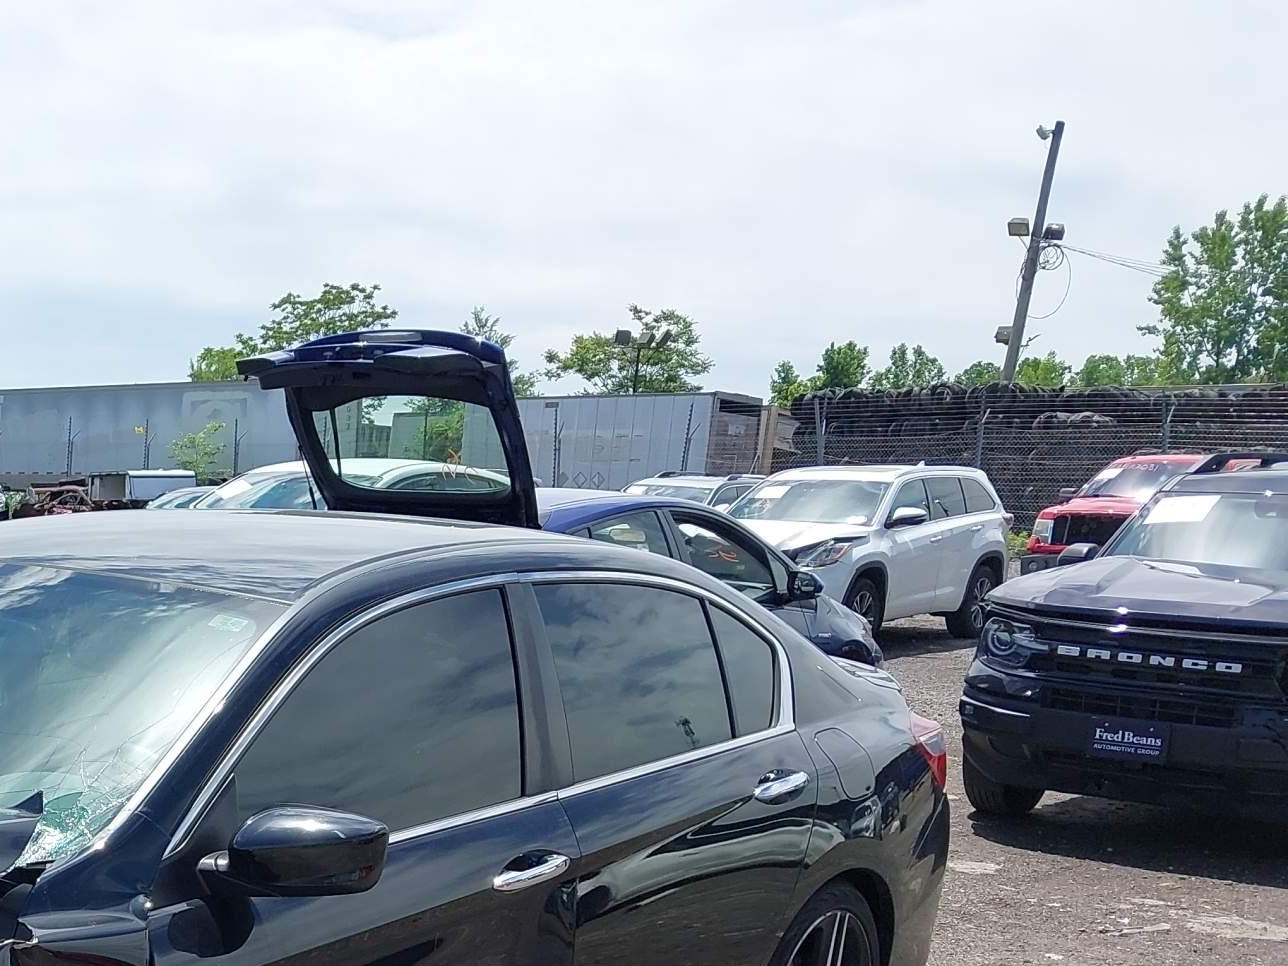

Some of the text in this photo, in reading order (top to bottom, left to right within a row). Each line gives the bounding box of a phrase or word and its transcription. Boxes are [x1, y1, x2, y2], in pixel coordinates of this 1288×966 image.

[1057, 645, 1242, 673] BRONCO
[1094, 727, 1162, 746] Fred Beans
[1093, 743, 1135, 753] AUTOMOTIVE
